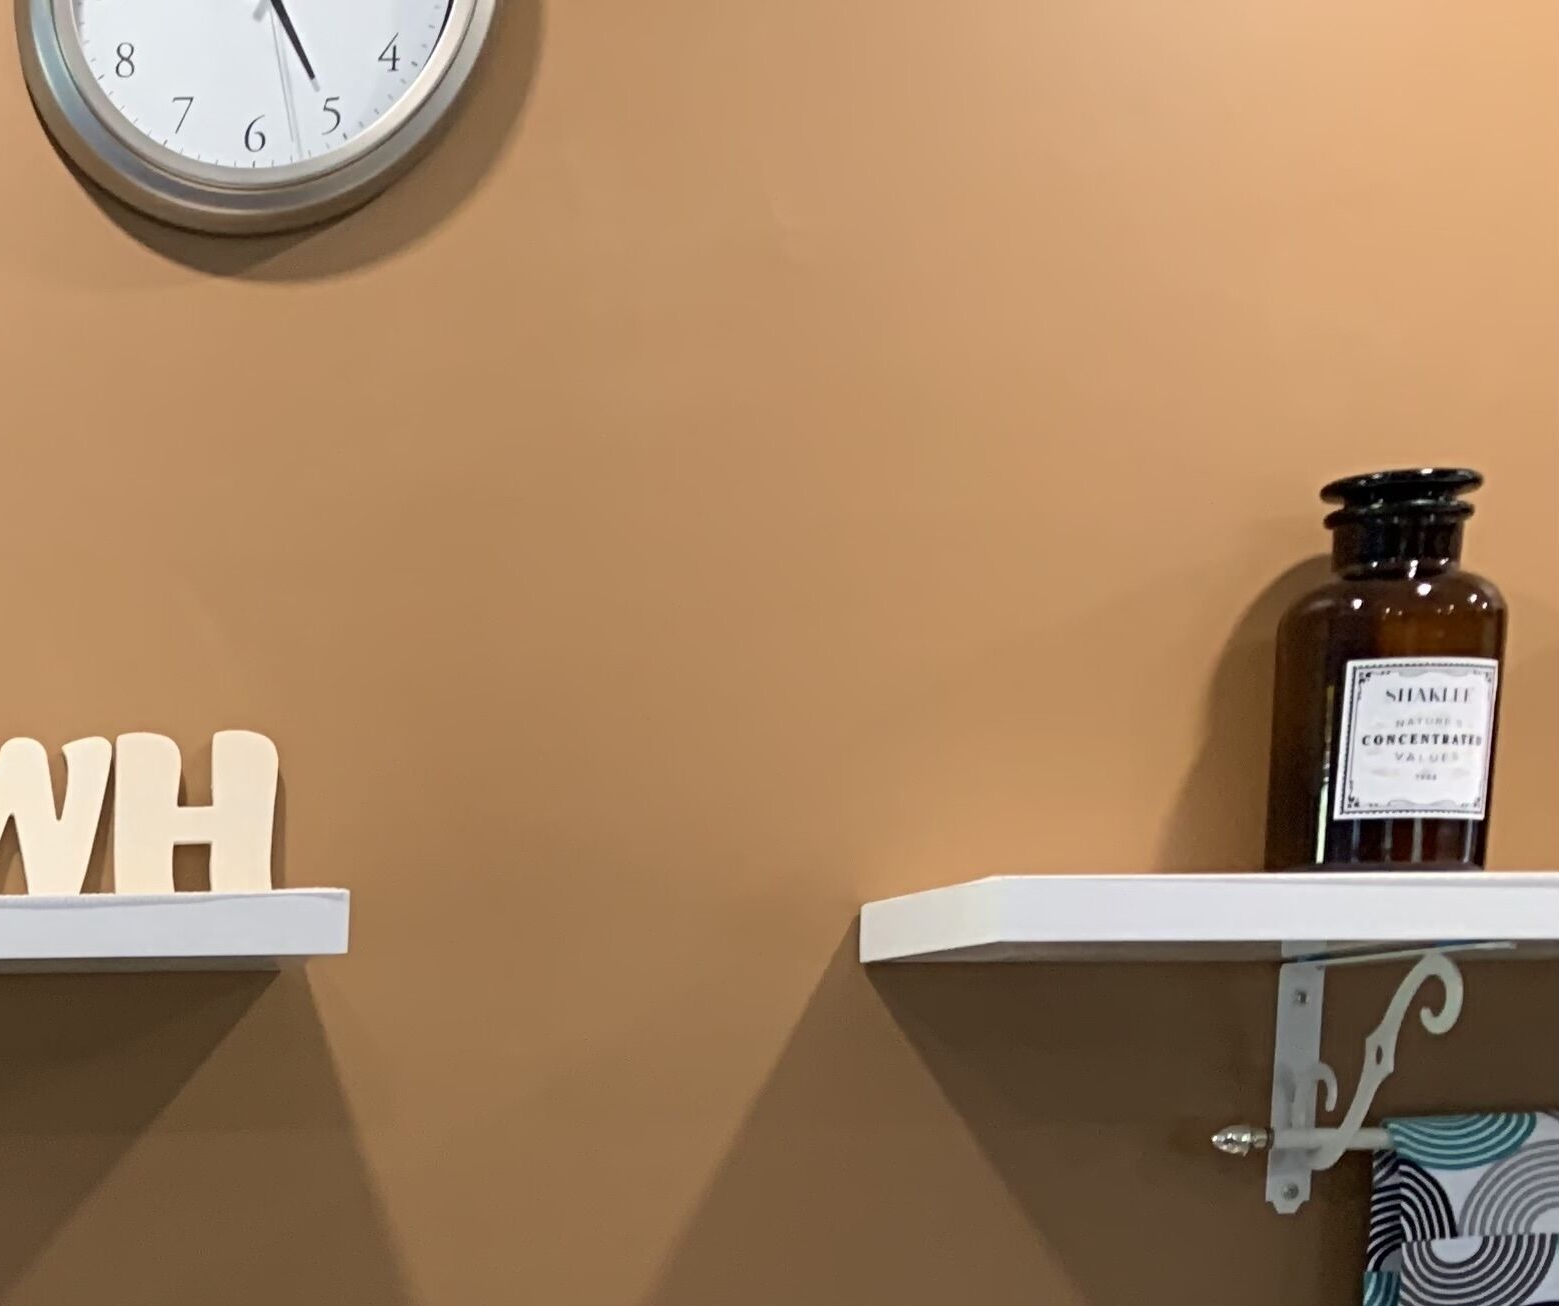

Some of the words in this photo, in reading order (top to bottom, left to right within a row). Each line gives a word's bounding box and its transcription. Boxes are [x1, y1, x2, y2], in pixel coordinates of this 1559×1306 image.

[115, 42, 135, 78] 8
[378, 32, 401, 72] 4
[172, 96, 195, 134] 7
[244, 114, 266, 153] 6
[321, 96, 341, 135] 5
[1361, 733, 1482, 747] CONCENTRATED
